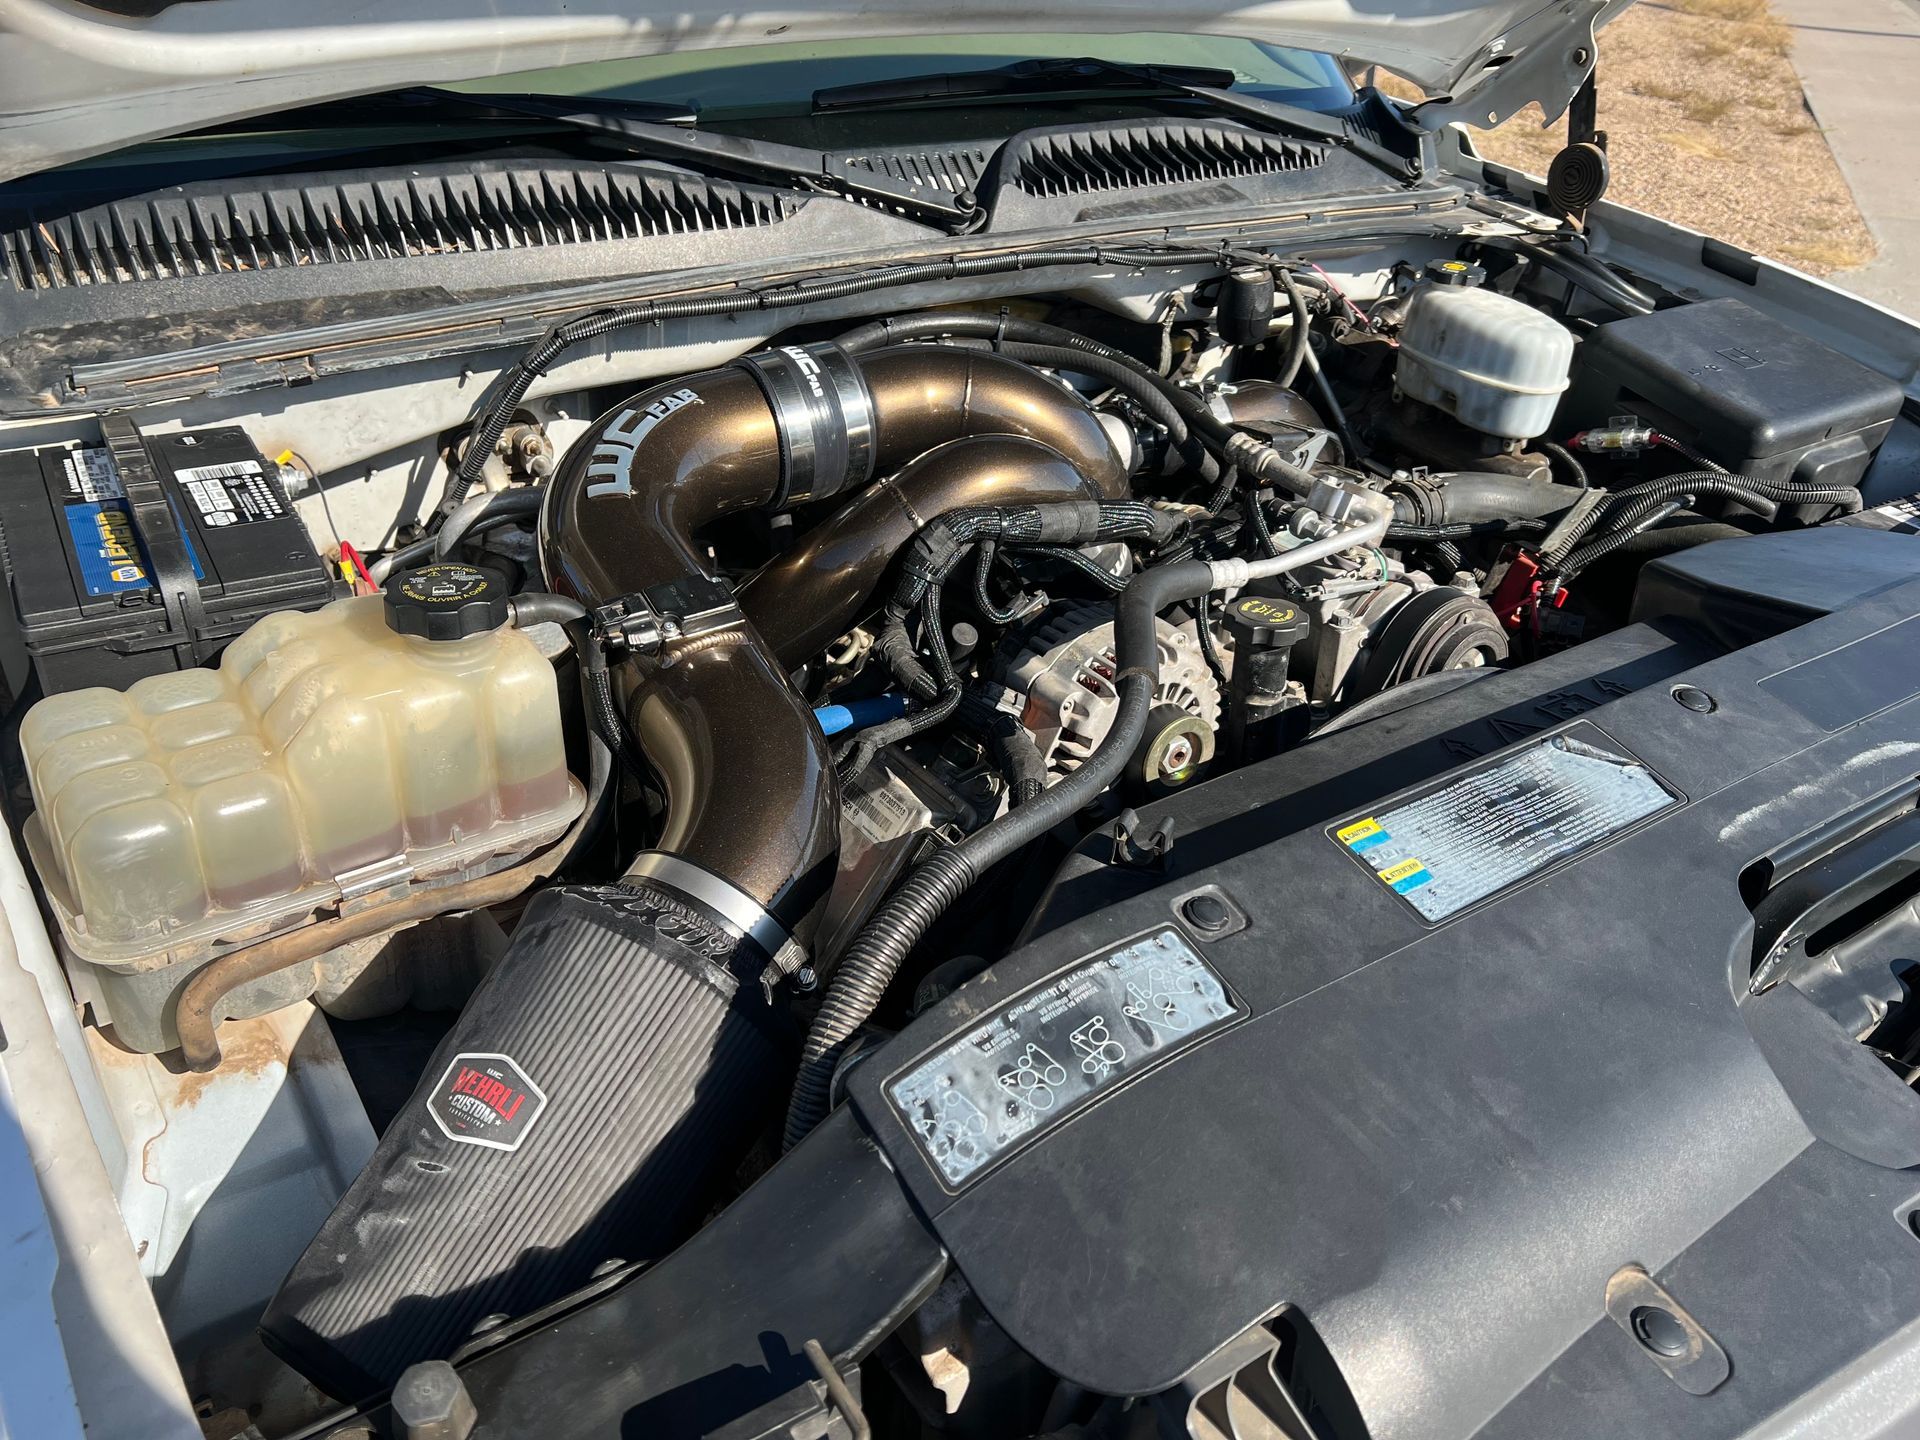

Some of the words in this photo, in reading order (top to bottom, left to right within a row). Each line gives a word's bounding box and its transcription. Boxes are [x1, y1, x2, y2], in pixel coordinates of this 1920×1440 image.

[781, 346, 821, 375] WC
[806, 374, 824, 398] FAB
[587, 409, 656, 499] WC
[646, 388, 699, 420] FAB
[450, 1066, 526, 1122] WEHRLI
[486, 1067, 504, 1080] WC
[450, 1094, 497, 1125] CUSTOM
